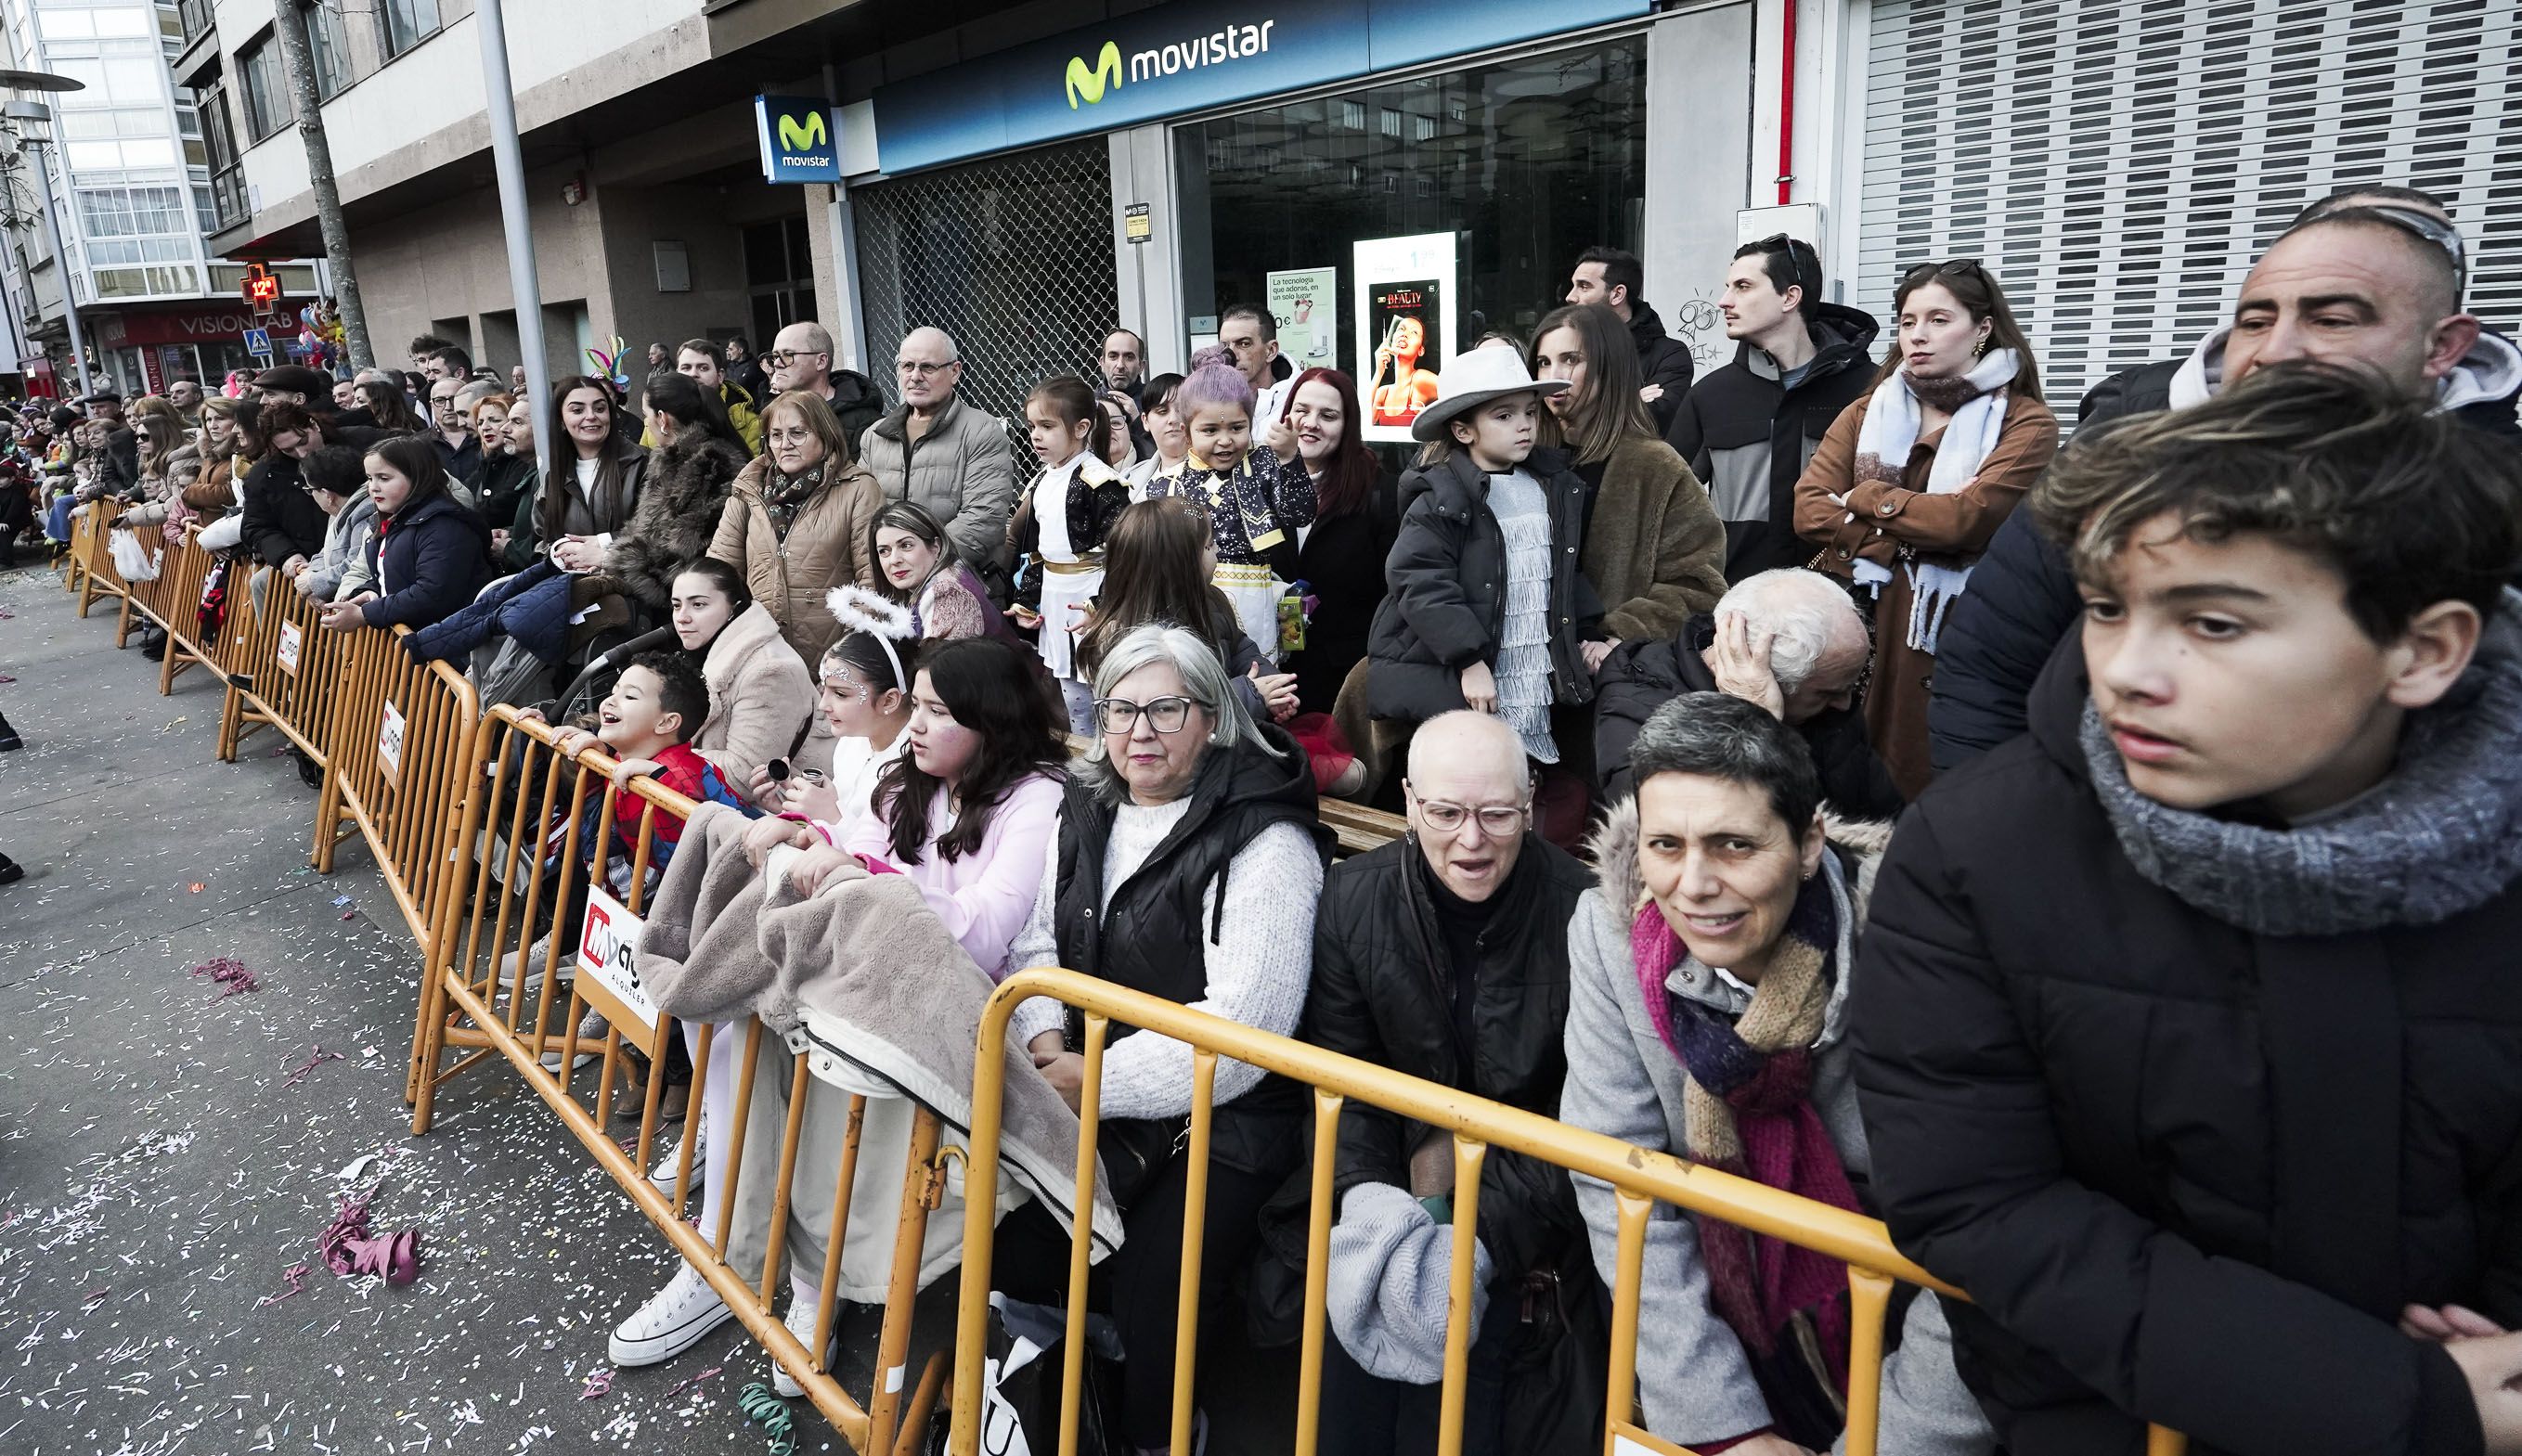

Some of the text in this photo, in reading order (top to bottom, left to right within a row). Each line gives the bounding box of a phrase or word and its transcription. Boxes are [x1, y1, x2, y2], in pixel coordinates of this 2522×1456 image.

[1131, 19, 1274, 83] movistar
[782, 156, 830, 167] movistar
[1387, 292, 1421, 304] BEAUTY
[180, 313, 293, 335] VISIONLAB
[611, 973, 646, 1006] ALQUILER
